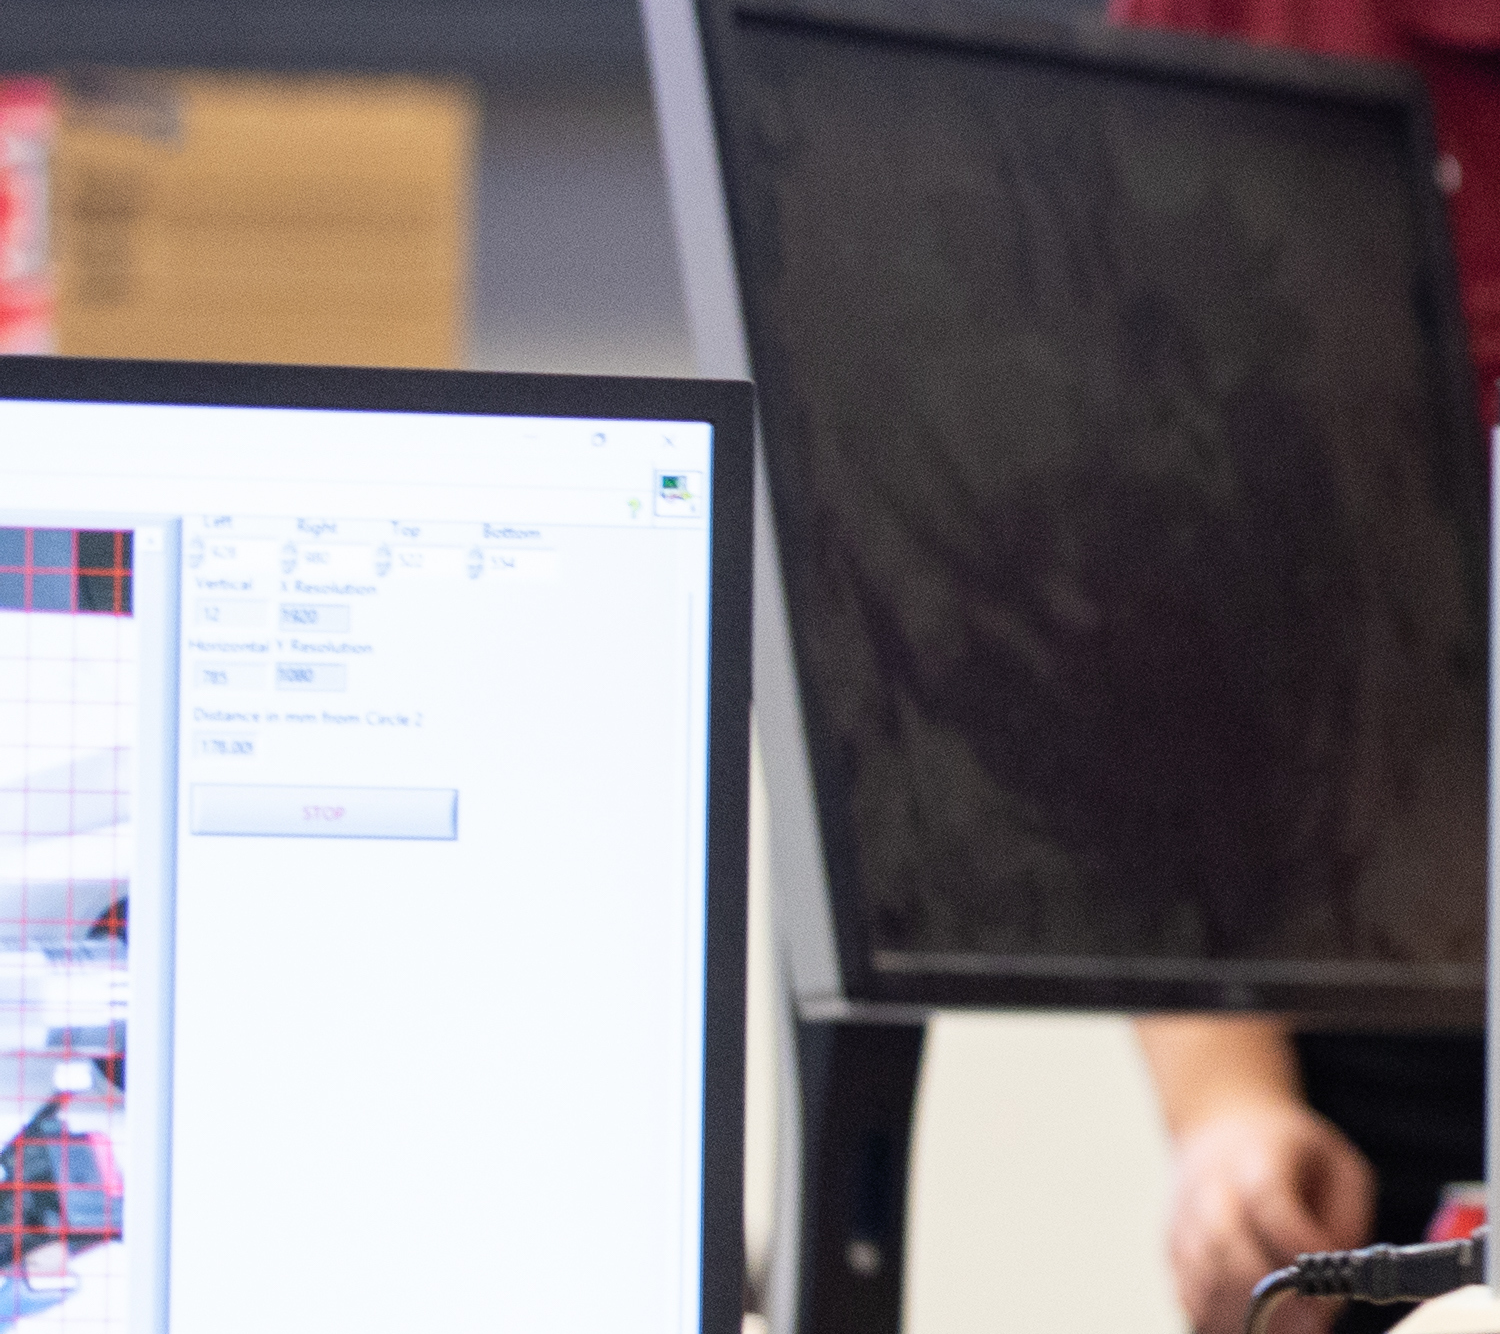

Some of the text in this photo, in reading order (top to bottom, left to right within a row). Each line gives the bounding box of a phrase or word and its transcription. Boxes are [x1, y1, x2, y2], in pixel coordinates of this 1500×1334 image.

[483, 522, 542, 540] Bottom
[295, 579, 376, 595] Resolution
[188, 638, 270, 654] Horizontal
[290, 638, 374, 655] Resolution
[194, 706, 260, 723] Distance
[321, 710, 360, 725] from
[365, 709, 410, 727] Circle
[302, 805, 346, 822] STOP
